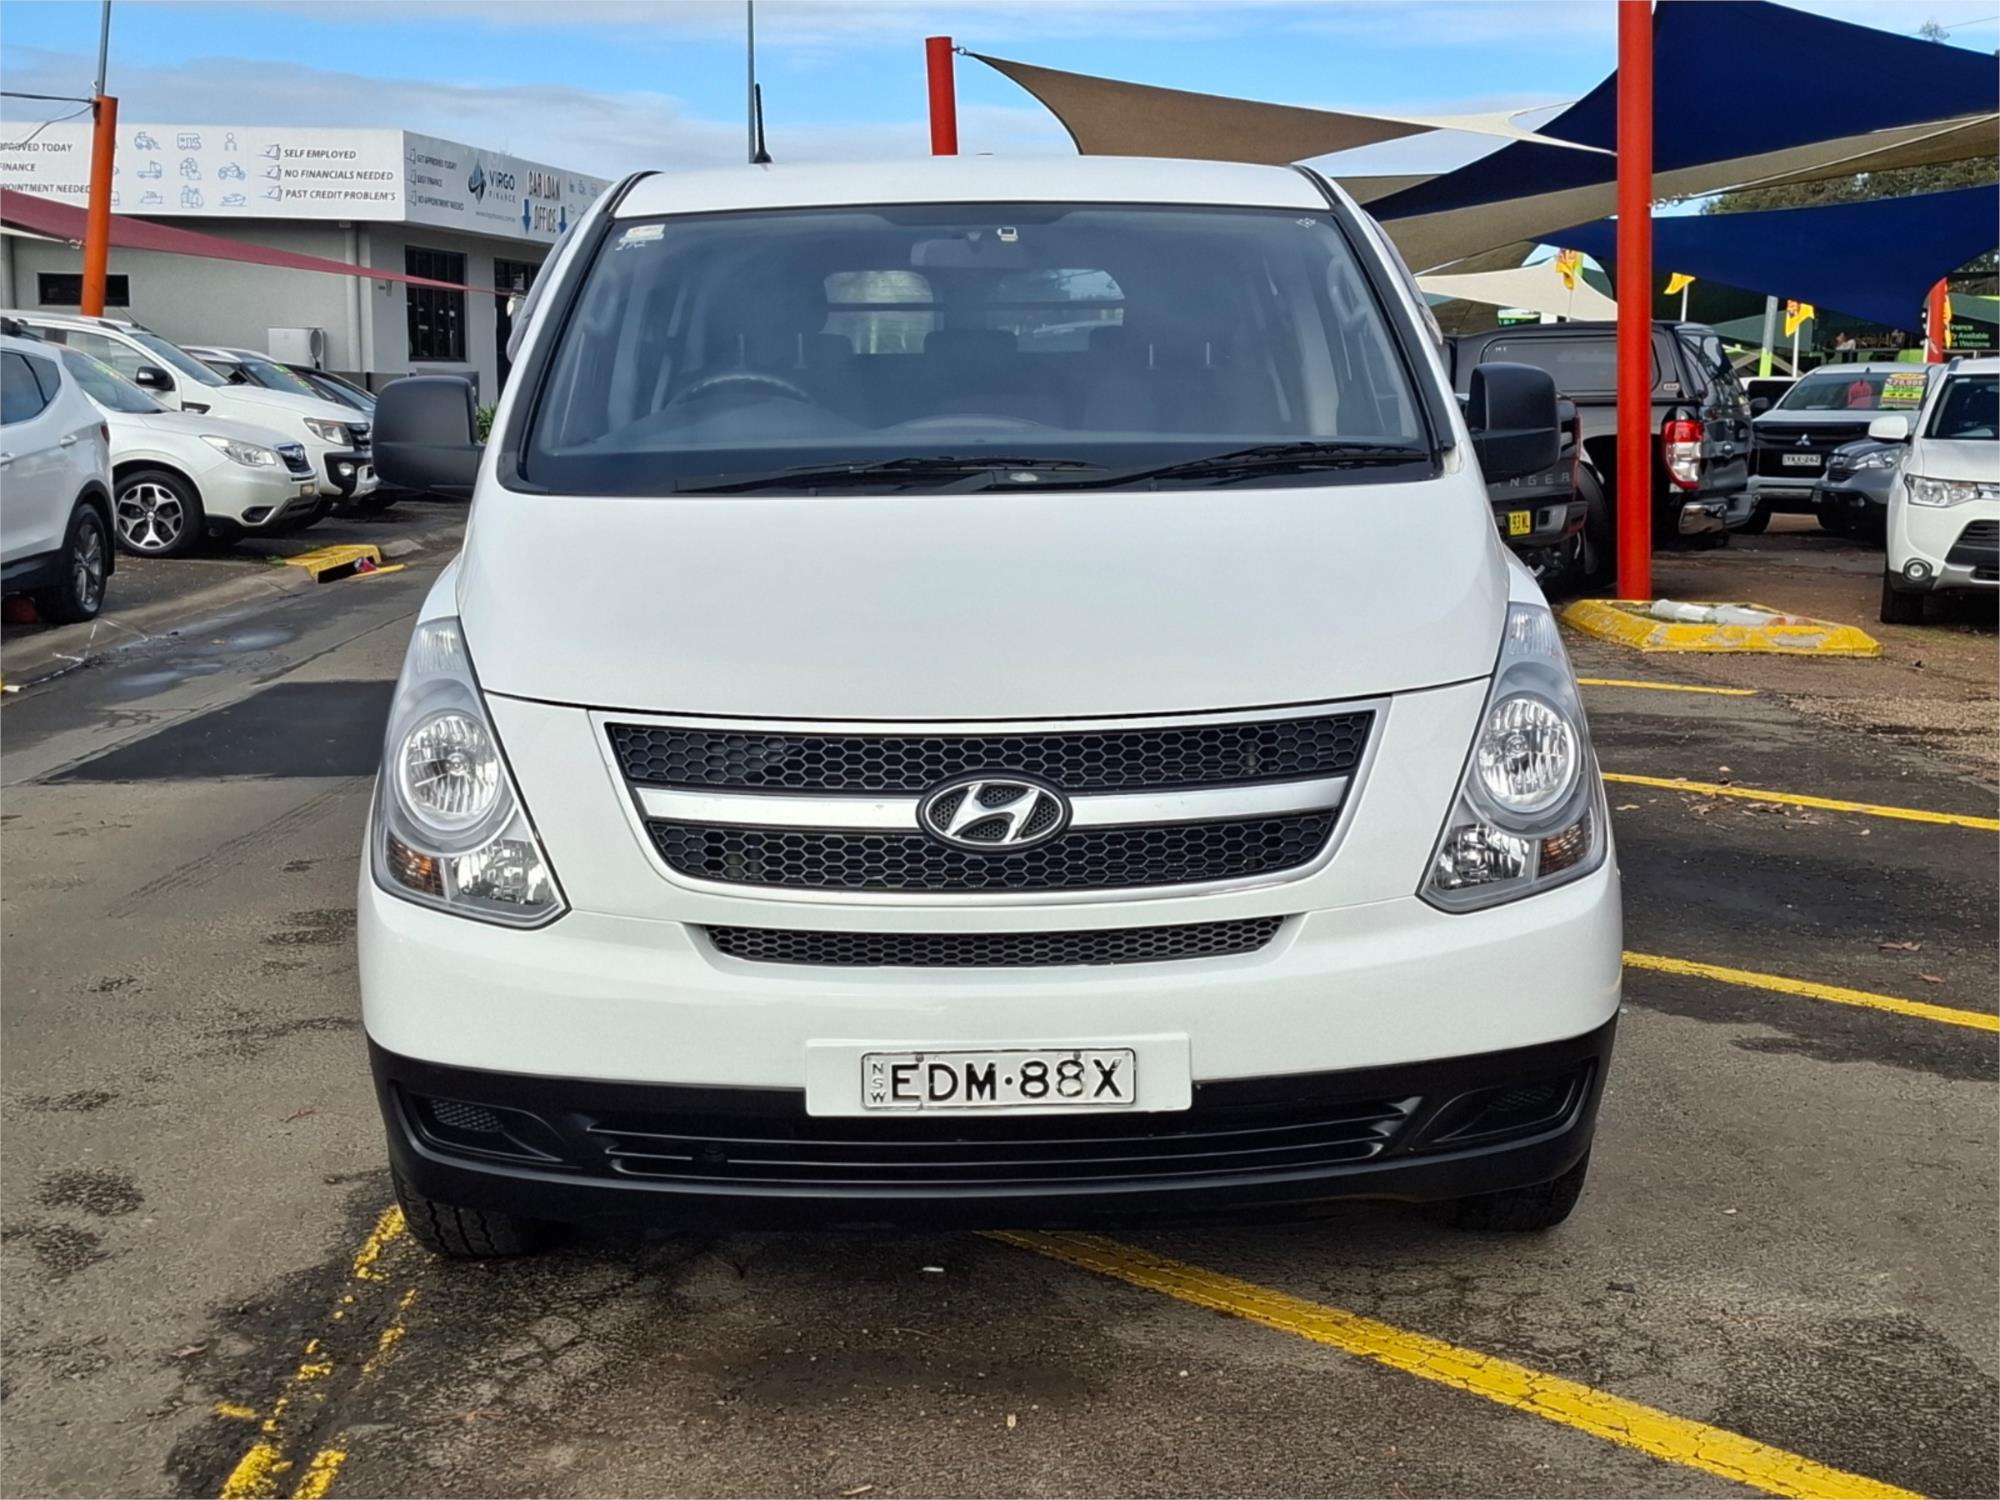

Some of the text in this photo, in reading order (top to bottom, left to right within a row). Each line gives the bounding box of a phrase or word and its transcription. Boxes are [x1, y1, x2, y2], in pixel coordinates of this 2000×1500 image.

[41, 143, 73, 153] TODAY
[283, 149, 357, 160] SELF EMPLOYED
[284, 169, 394, 181] NO FINANCIALS NEEDED
[489, 170, 515, 191] VIRGO
[285, 189, 396, 201] PAST CREDIT PROBLEM'S
